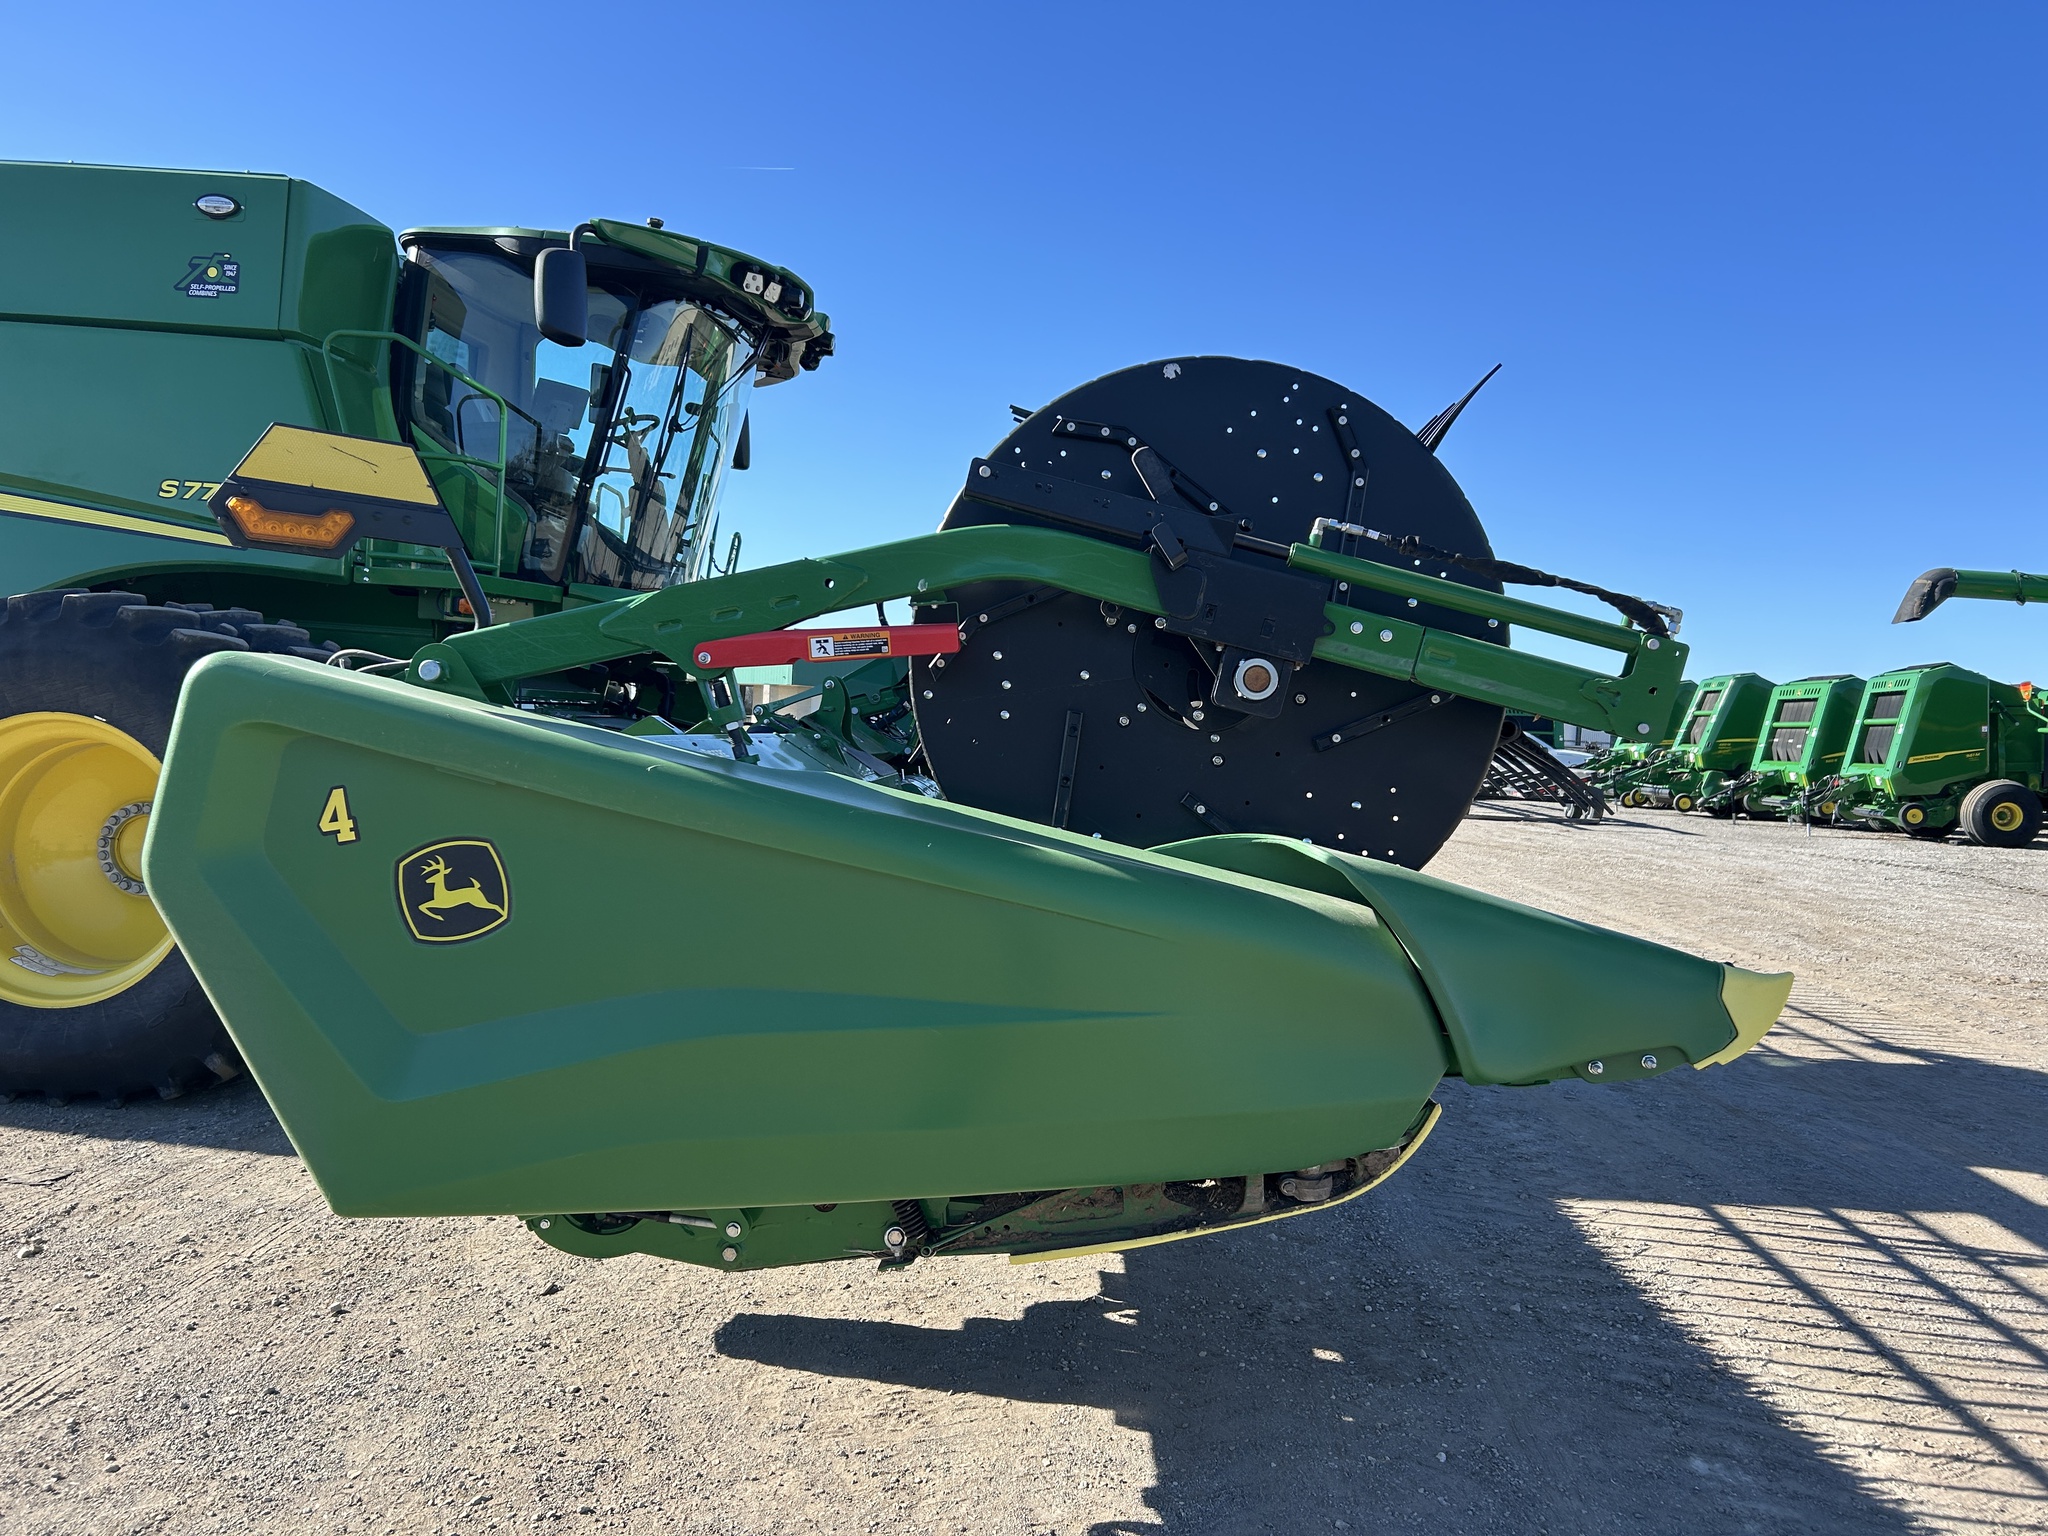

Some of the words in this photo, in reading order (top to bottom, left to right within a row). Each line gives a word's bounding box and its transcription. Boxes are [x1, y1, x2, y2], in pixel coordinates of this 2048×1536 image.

[190, 283, 236, 292] SELF-PROPELLED
[188, 289, 218, 297] COMBINES
[850, 632, 881, 640] WARNING
[318, 787, 357, 843] 4
